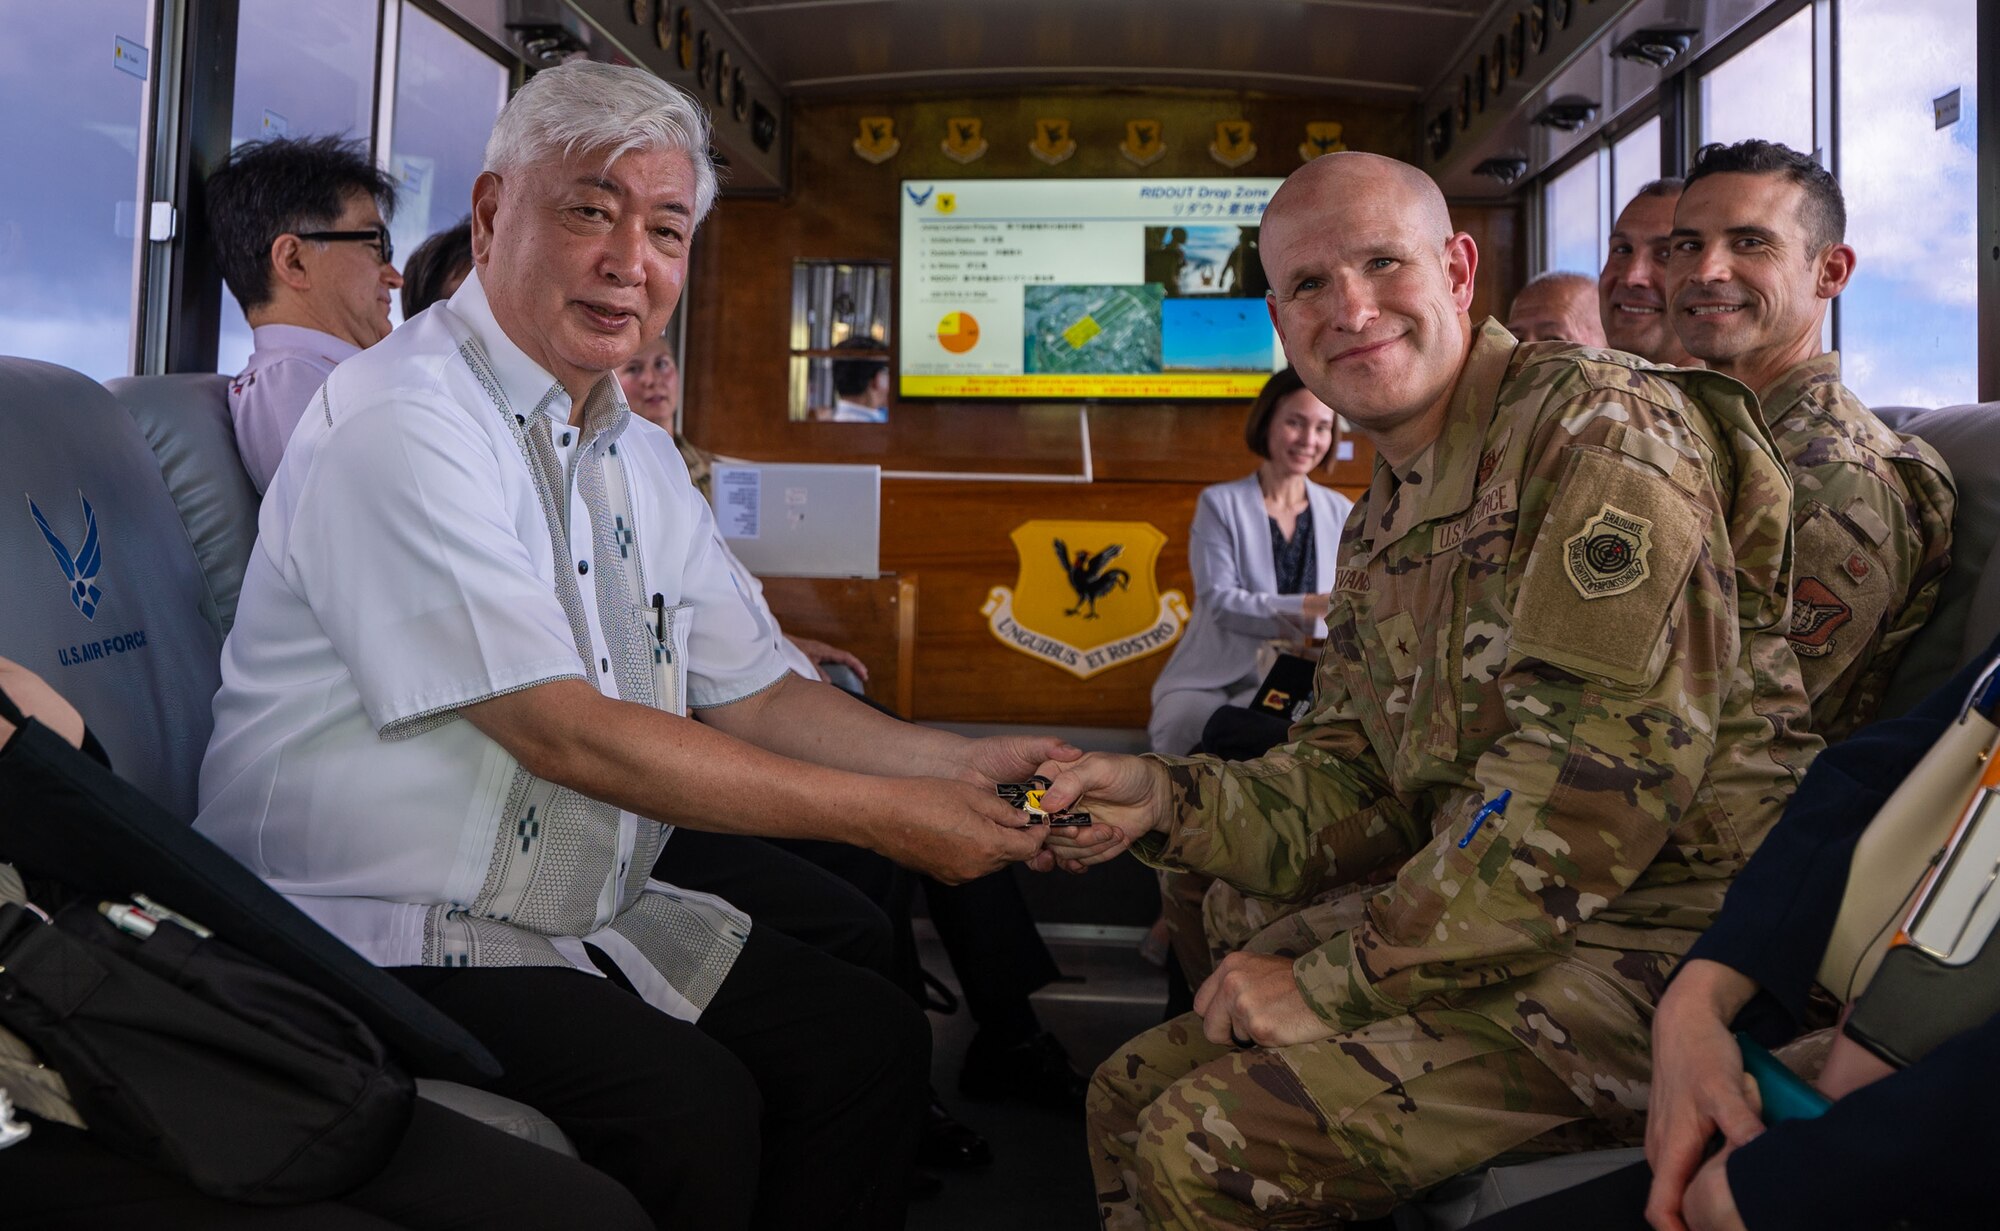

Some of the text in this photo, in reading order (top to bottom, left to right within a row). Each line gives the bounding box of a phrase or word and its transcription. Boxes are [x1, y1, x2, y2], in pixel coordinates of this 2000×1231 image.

[1141, 186, 1269, 200] RIDOUT Drop Zone
[1602, 511, 1645, 535] GRADUATE
[102, 630, 148, 656] FORCE
[998, 617, 1175, 669] UNGUIBUS ET ROSTRO
